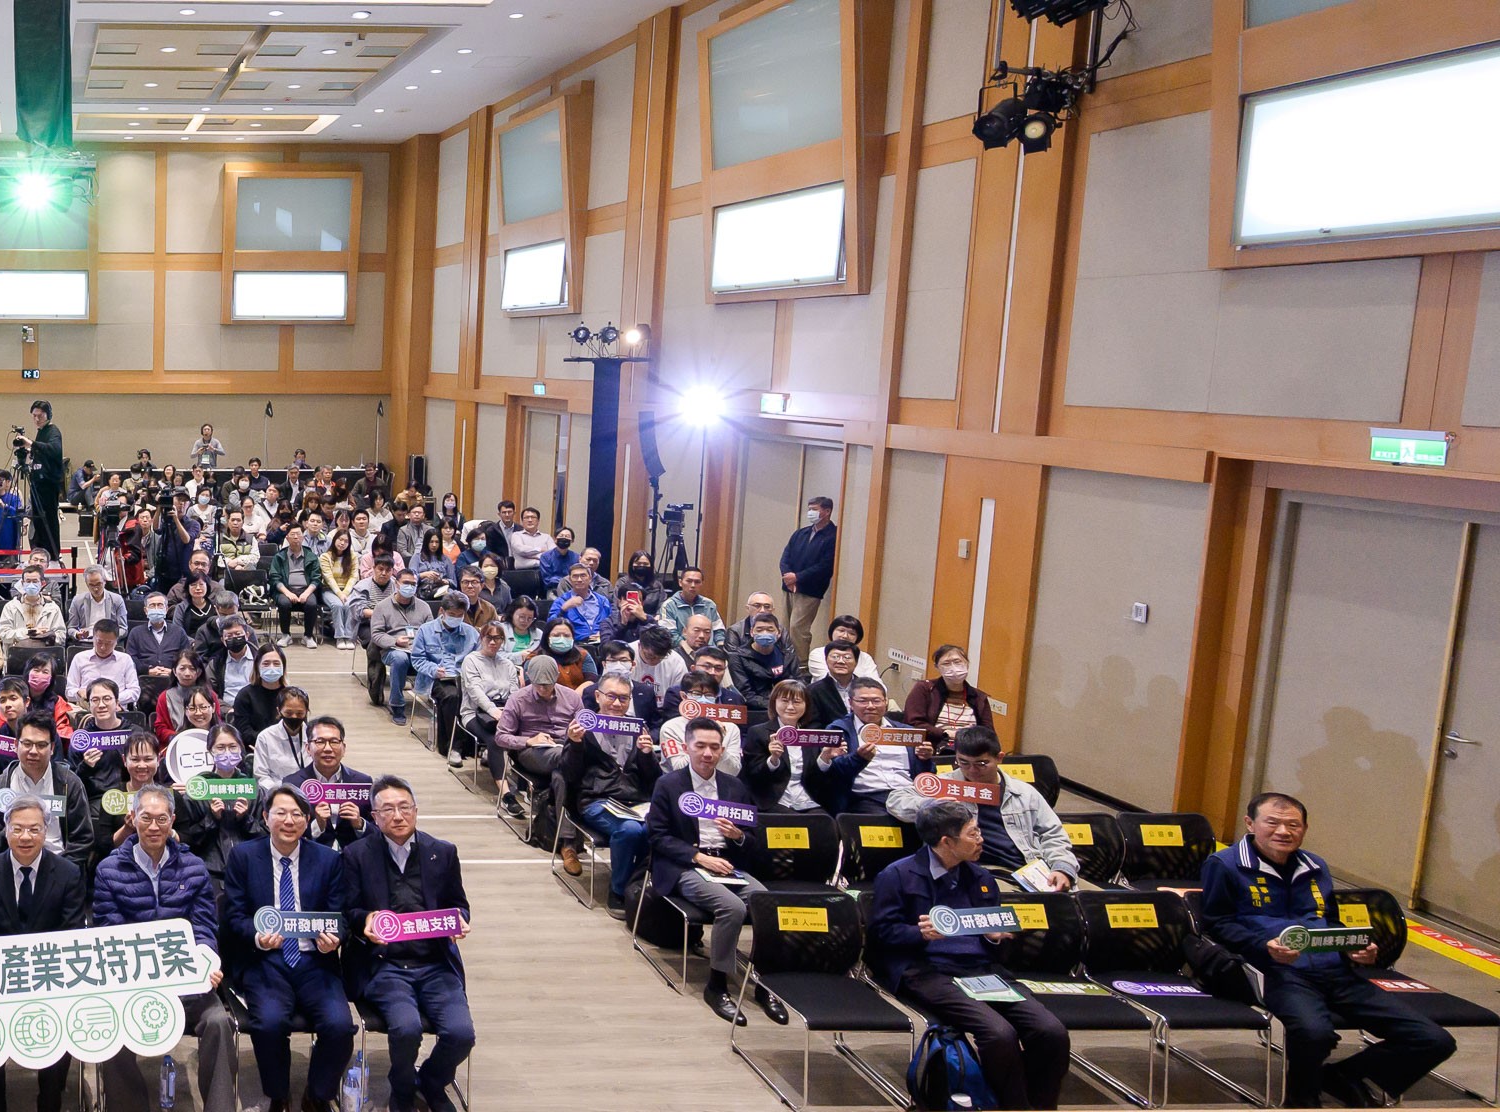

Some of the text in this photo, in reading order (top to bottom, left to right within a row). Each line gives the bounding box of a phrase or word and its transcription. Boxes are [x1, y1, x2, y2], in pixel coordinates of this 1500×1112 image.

[705, 707, 742, 720] 注資金
[597, 719, 641, 733] 外銷拓點
[798, 734, 840, 744] 金融支持
[883, 733, 923, 743] 安定就業
[209, 784, 254, 795] 訓練有津貼
[325, 789, 369, 800] 金融支持
[947, 784, 993, 800] 注資金
[704, 803, 754, 822] 外銷拓點
[868, 834, 894, 842] 公協會
[283, 918, 339, 933] 研發轉型
[402, 915, 457, 934] 金融支持
[959, 911, 1016, 929] 研發轉型
[1311, 934, 1369, 947] 訓練有津貼
